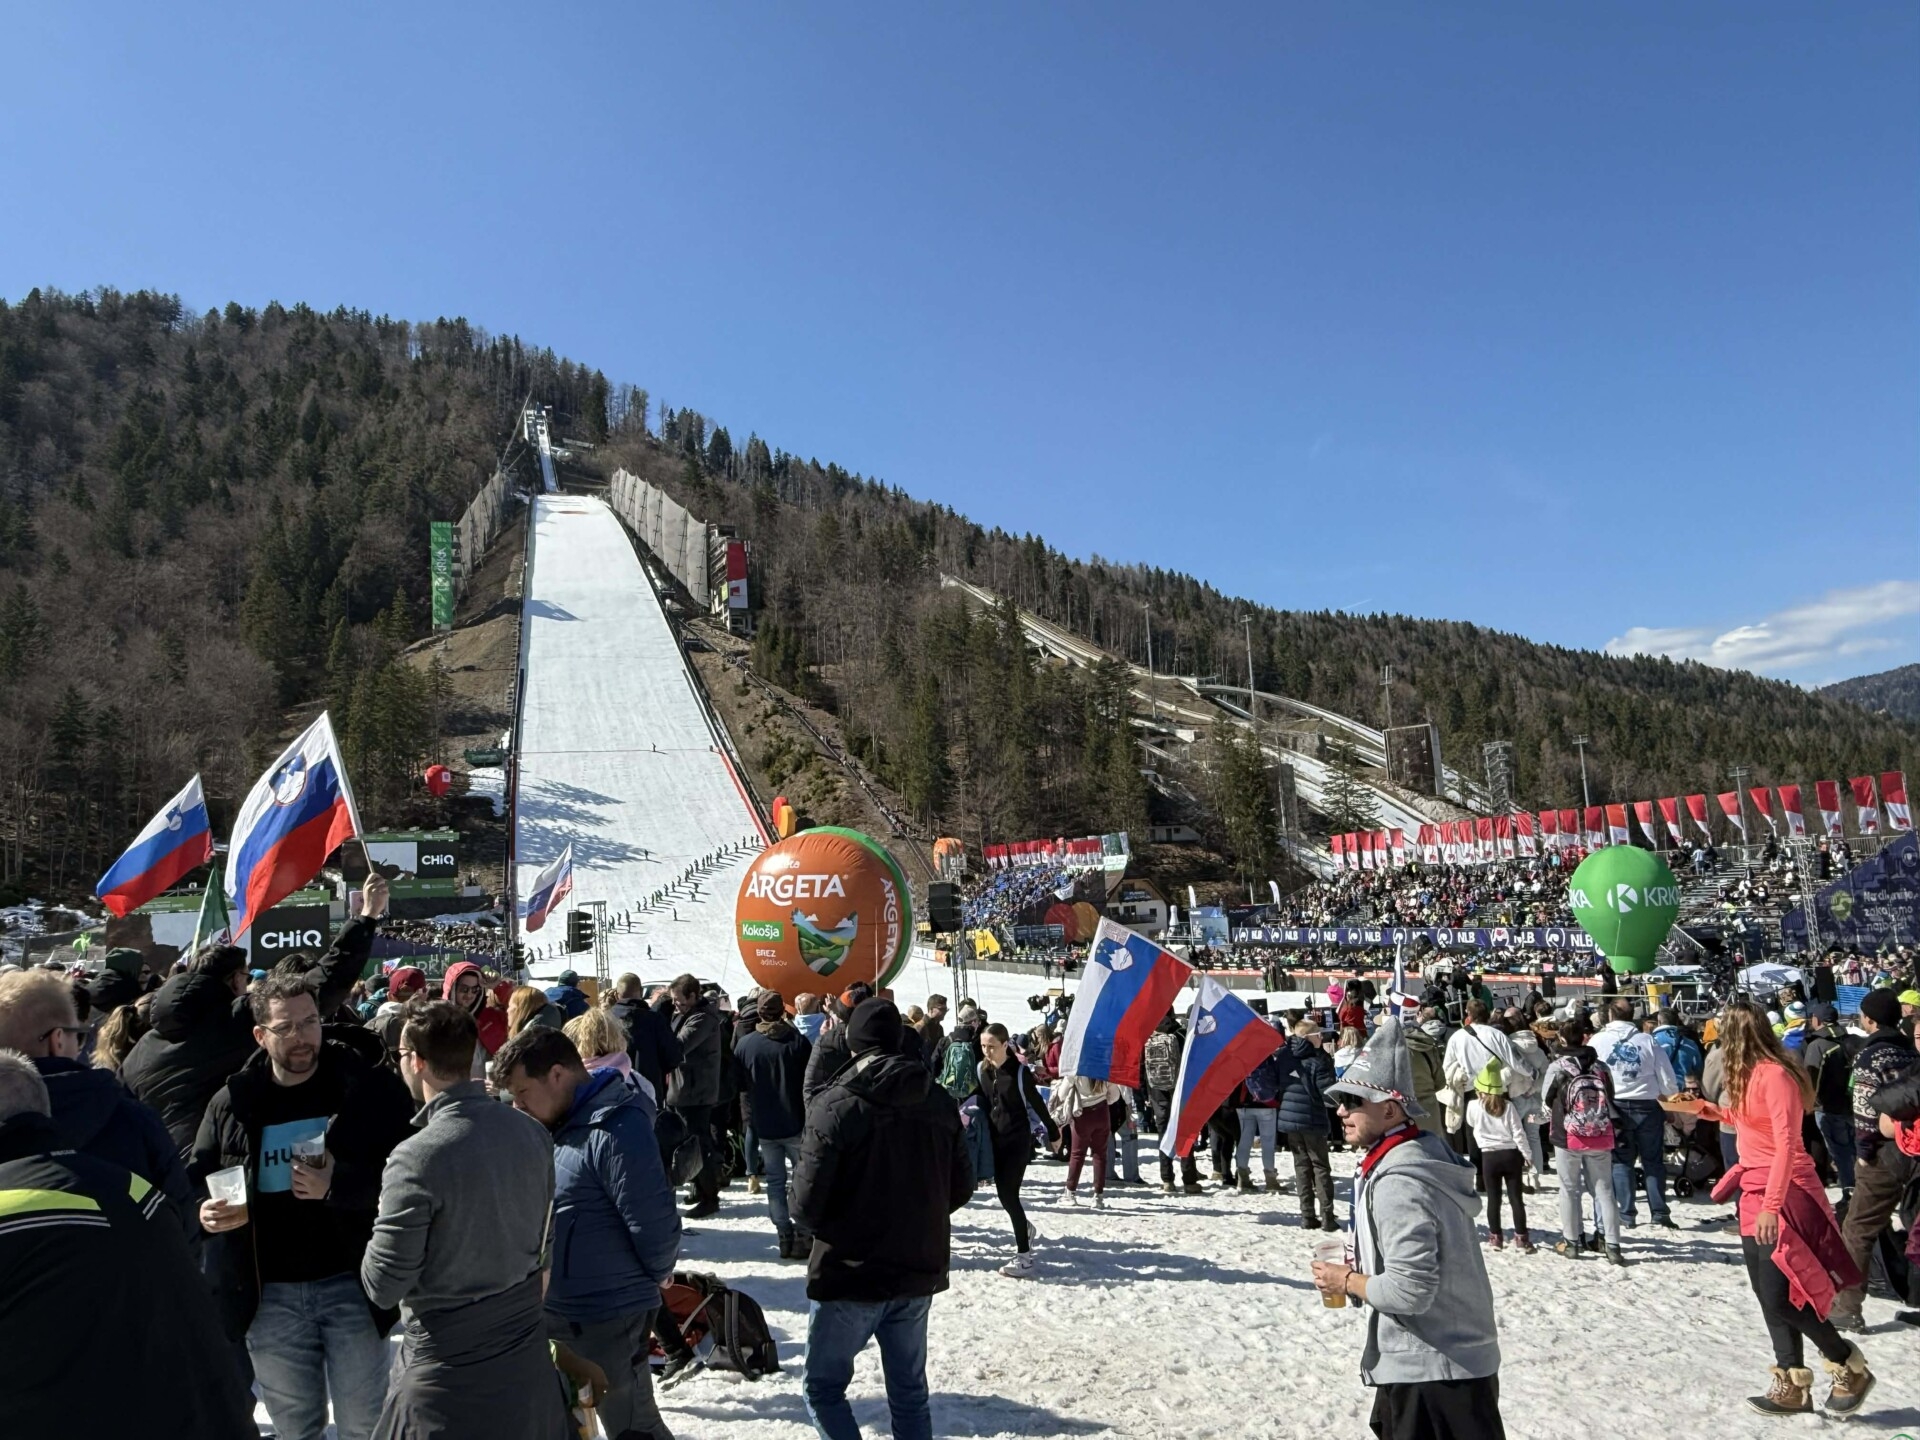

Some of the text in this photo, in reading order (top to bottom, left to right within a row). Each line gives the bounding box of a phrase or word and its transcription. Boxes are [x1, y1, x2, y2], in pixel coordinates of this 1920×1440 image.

[421, 854, 455, 866] CHiQ
[745, 871, 846, 907] ARGETA
[880, 877, 898, 960] ARGETA
[742, 923, 780, 940] Kokošja
[1251, 930, 1263, 940] NLB
[1284, 930, 1299, 941] NLB
[1323, 931, 1338, 942] NLB
[1364, 931, 1382, 943] NLB
[1457, 931, 1476, 944] NLB
[260, 929, 322, 949] CHiQ
[1570, 935, 1594, 948] NLB
[264, 1148, 293, 1168] HU
